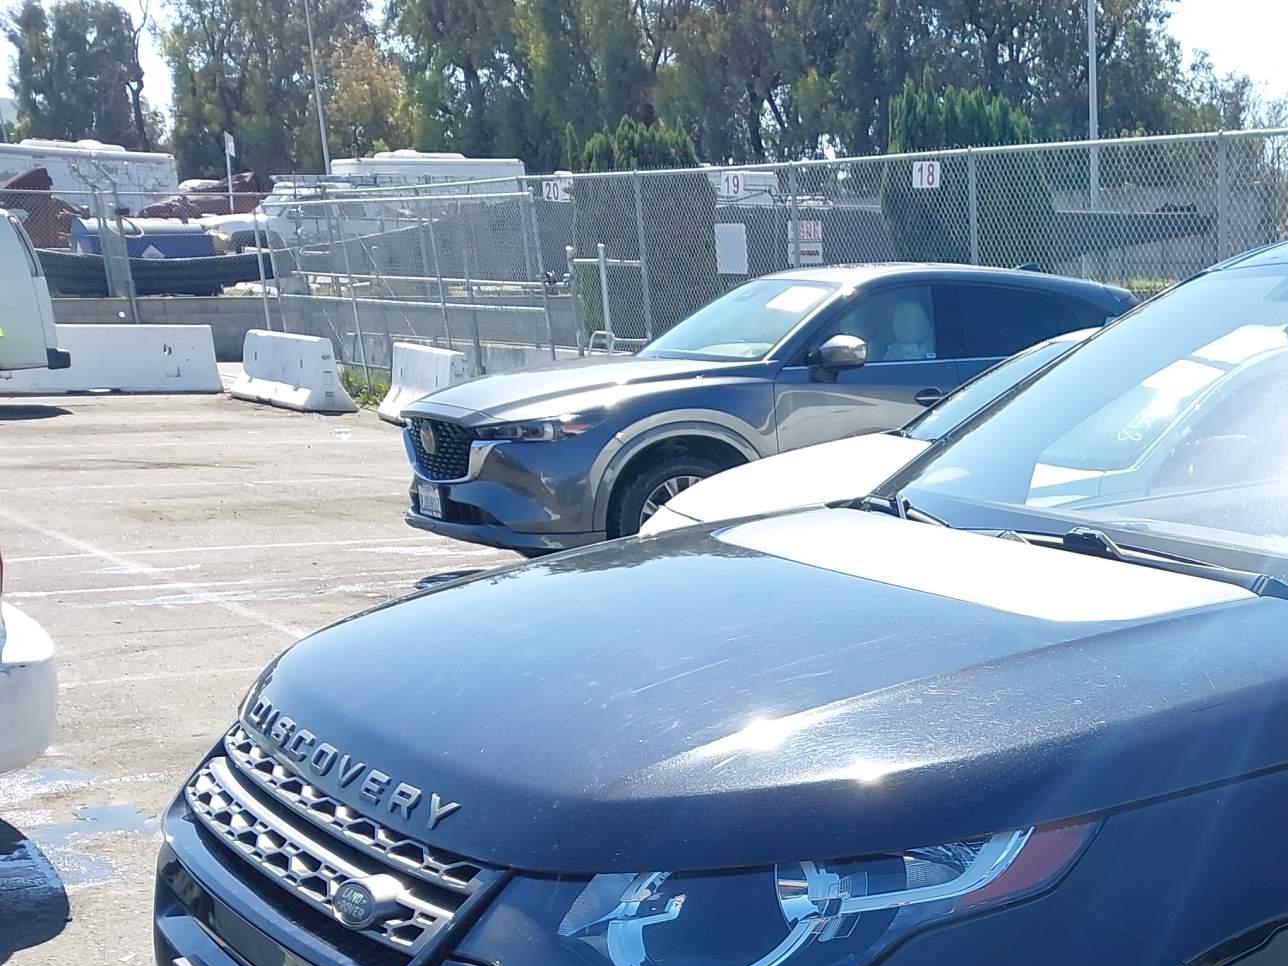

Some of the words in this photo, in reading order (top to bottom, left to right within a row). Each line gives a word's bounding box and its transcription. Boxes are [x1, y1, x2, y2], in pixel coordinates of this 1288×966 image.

[917, 162, 935, 187] 18
[545, 182, 559, 200] 20
[724, 175, 740, 195] 19
[250, 695, 462, 831] DISCOVERY
[341, 887, 364, 904] LAND
[341, 900, 365, 920] ROVER
